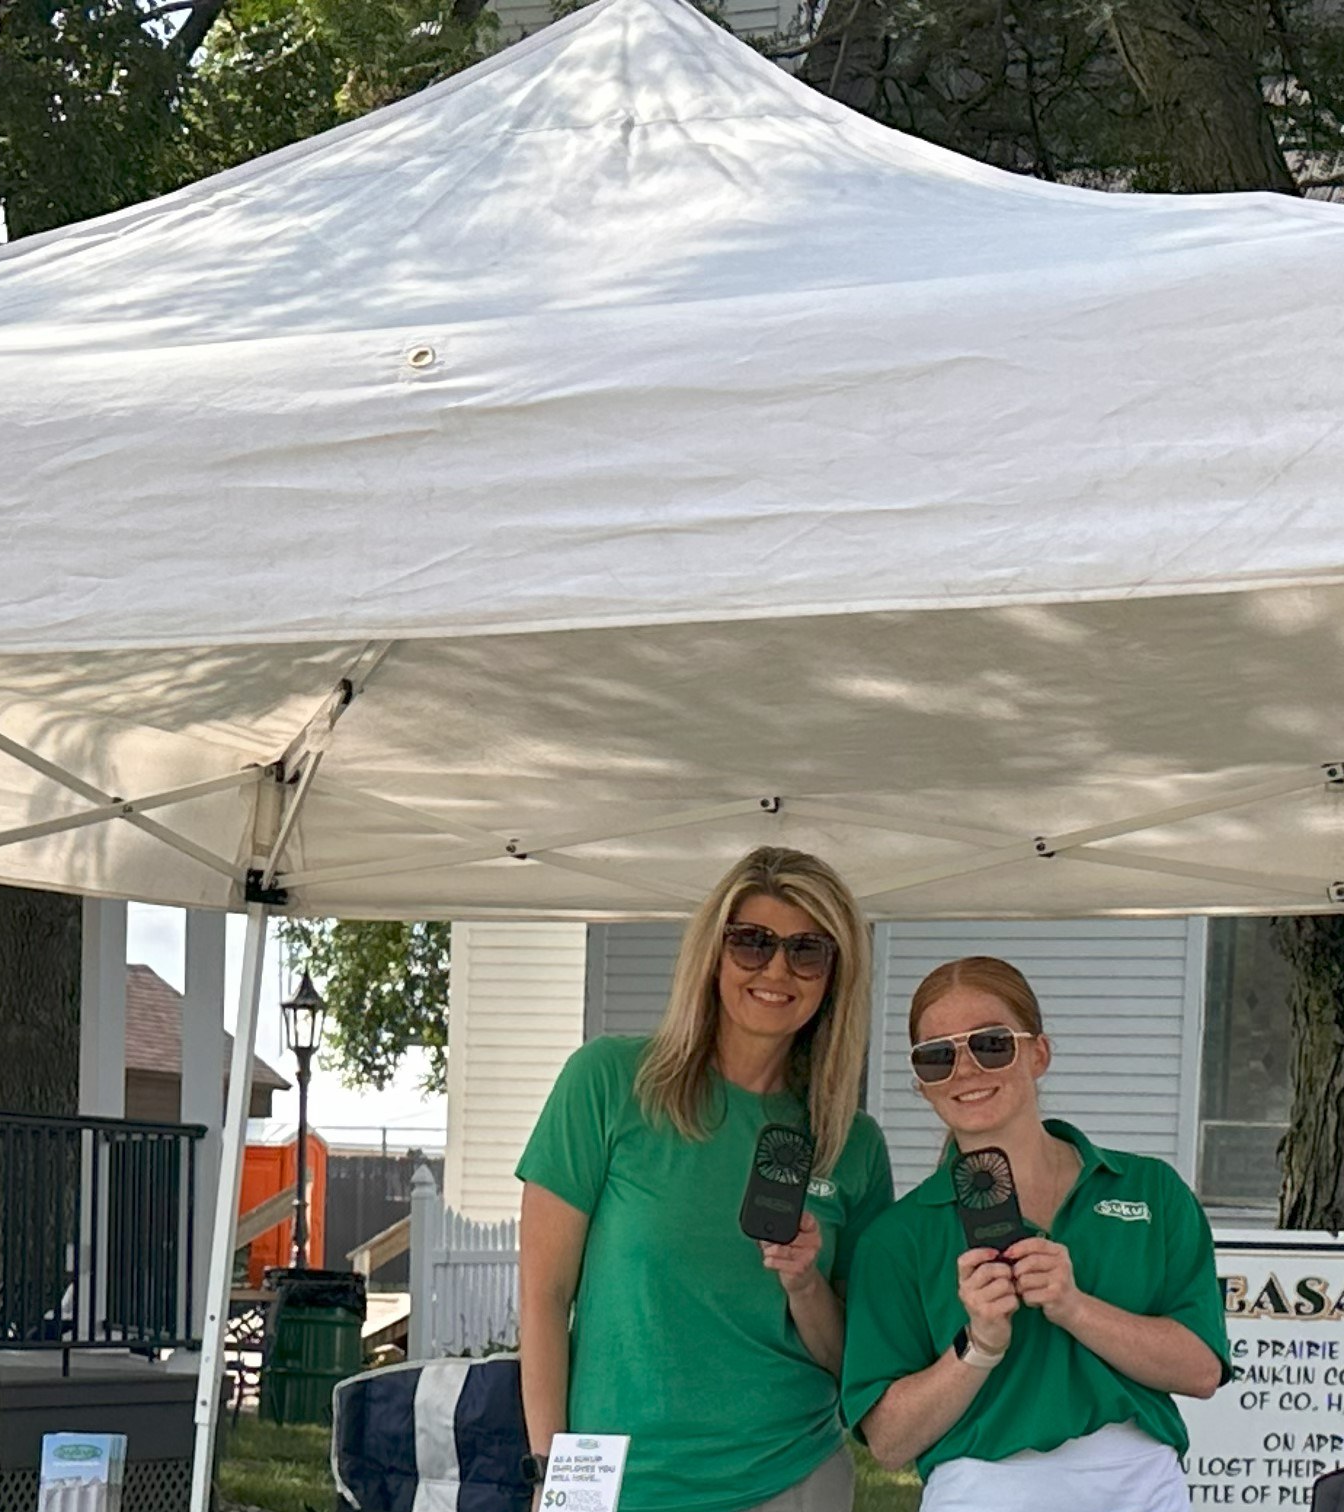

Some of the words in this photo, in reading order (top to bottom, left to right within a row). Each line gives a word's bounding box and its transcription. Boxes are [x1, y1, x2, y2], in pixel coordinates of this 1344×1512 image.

[1257, 1339, 1340, 1360] PRAIRIE
[1231, 1365, 1315, 1387] RANKLIN
[1240, 1391, 1270, 1410] OF
[1279, 1391, 1318, 1412] CO.
[1263, 1432, 1295, 1451] ON
[1198, 1457, 1257, 1477] LOST
[1263, 1458, 1326, 1478] THEIR
[544, 1488, 567, 1509] $0
[1188, 1484, 1235, 1504] TTLE
[1241, 1484, 1271, 1504] OF
